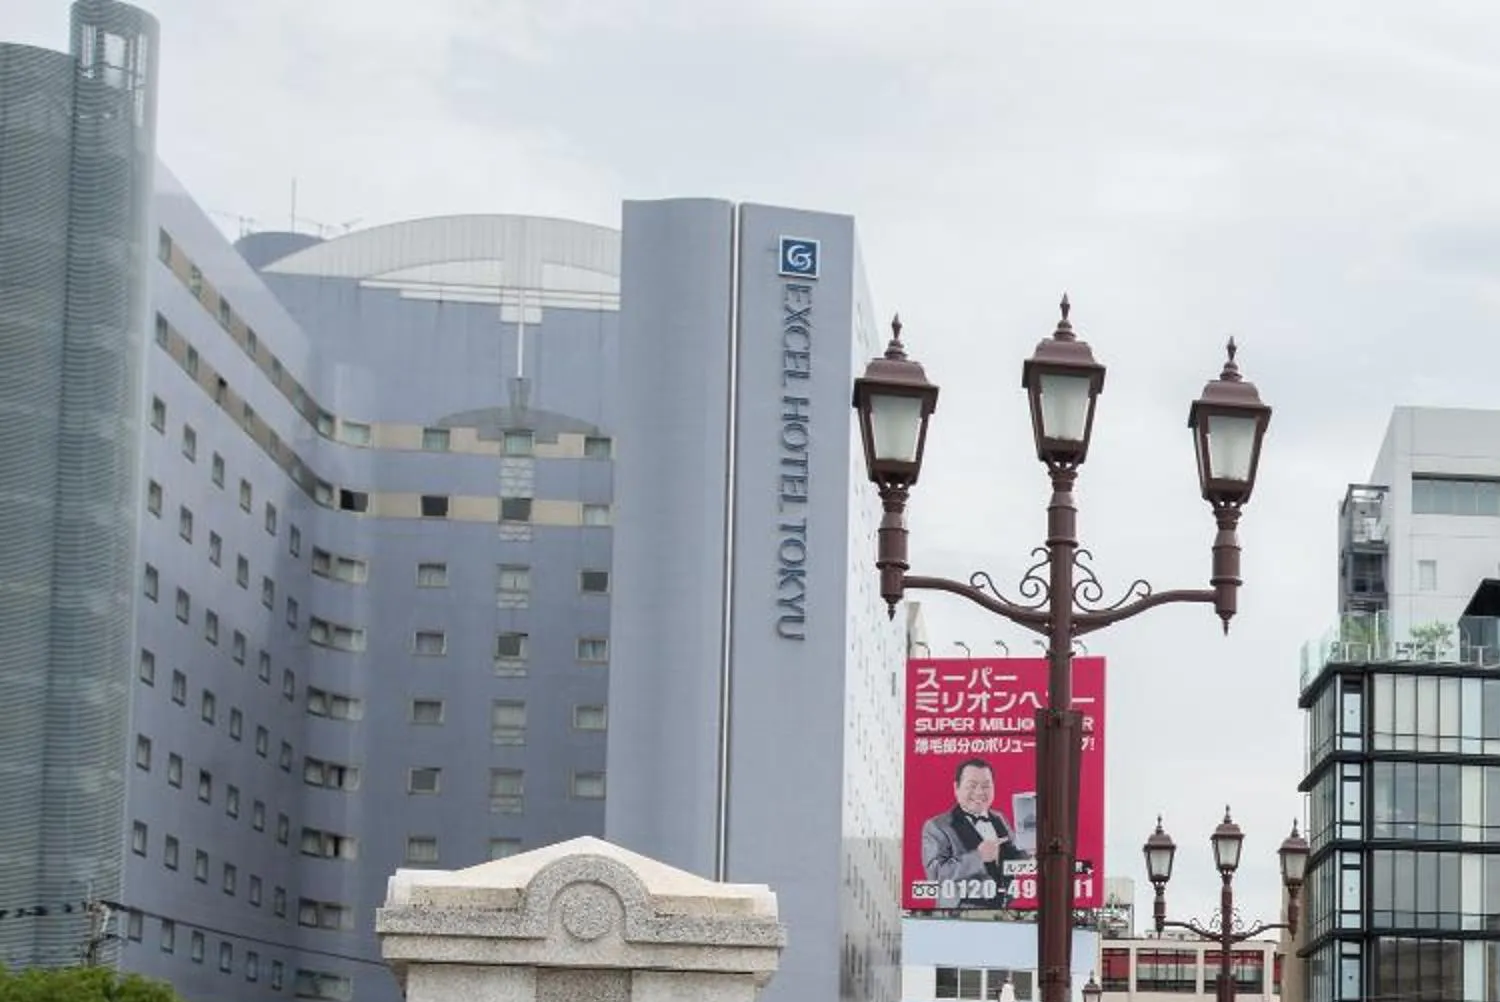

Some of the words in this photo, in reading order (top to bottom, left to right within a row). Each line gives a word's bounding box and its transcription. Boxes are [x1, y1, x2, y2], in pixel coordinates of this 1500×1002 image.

[783, 283, 812, 387] EXCEL
[780, 396, 810, 513] HOTEL
[776, 517, 808, 641] TOKYU
[915, 691, 1096, 713] ミリオンヘー
[916, 667, 1018, 690] スーパー
[914, 718, 975, 732] SUPER
[980, 718, 1036, 731] MILLIO
